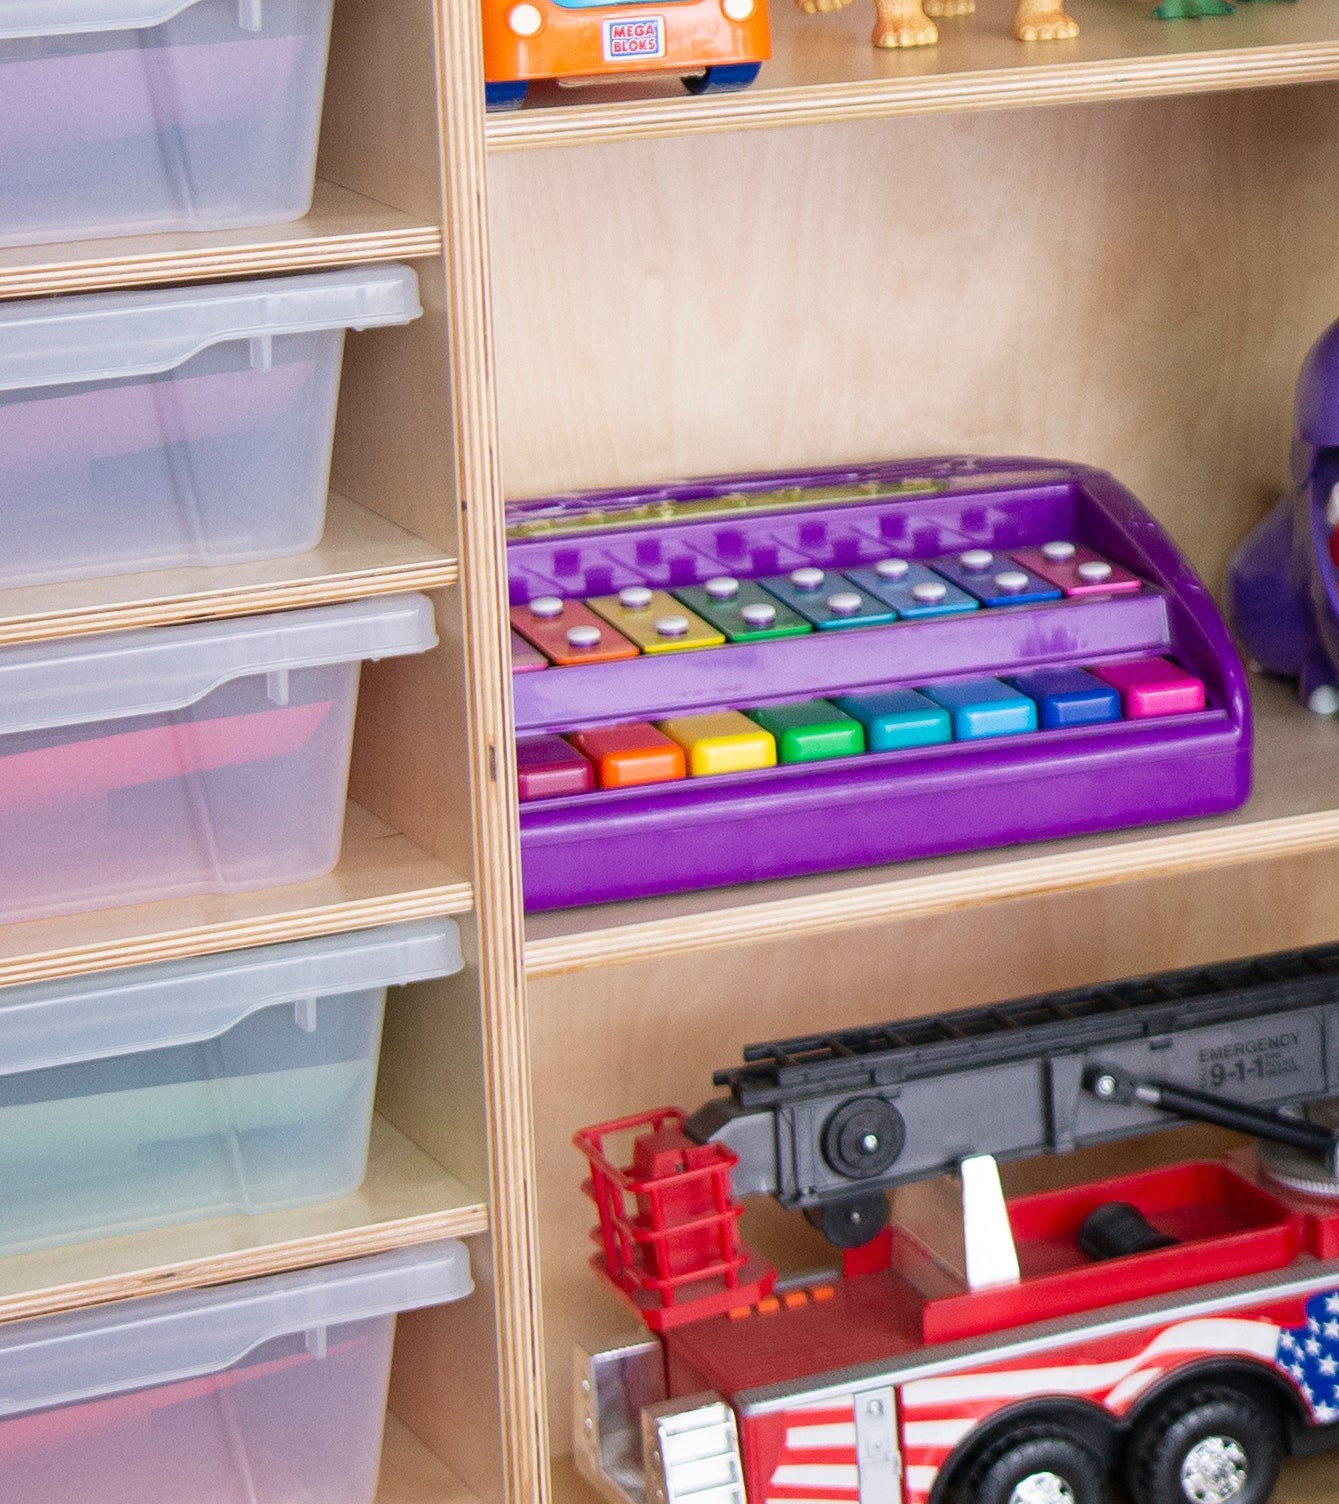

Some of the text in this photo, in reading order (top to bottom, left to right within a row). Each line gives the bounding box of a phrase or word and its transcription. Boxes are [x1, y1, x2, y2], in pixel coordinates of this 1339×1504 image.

[613, 24, 654, 38] MEGA
[613, 38, 656, 53] BLOKS
[1199, 1032, 1299, 1062] EMERGENCY
[1210, 1055, 1264, 1088] 9-1-1
